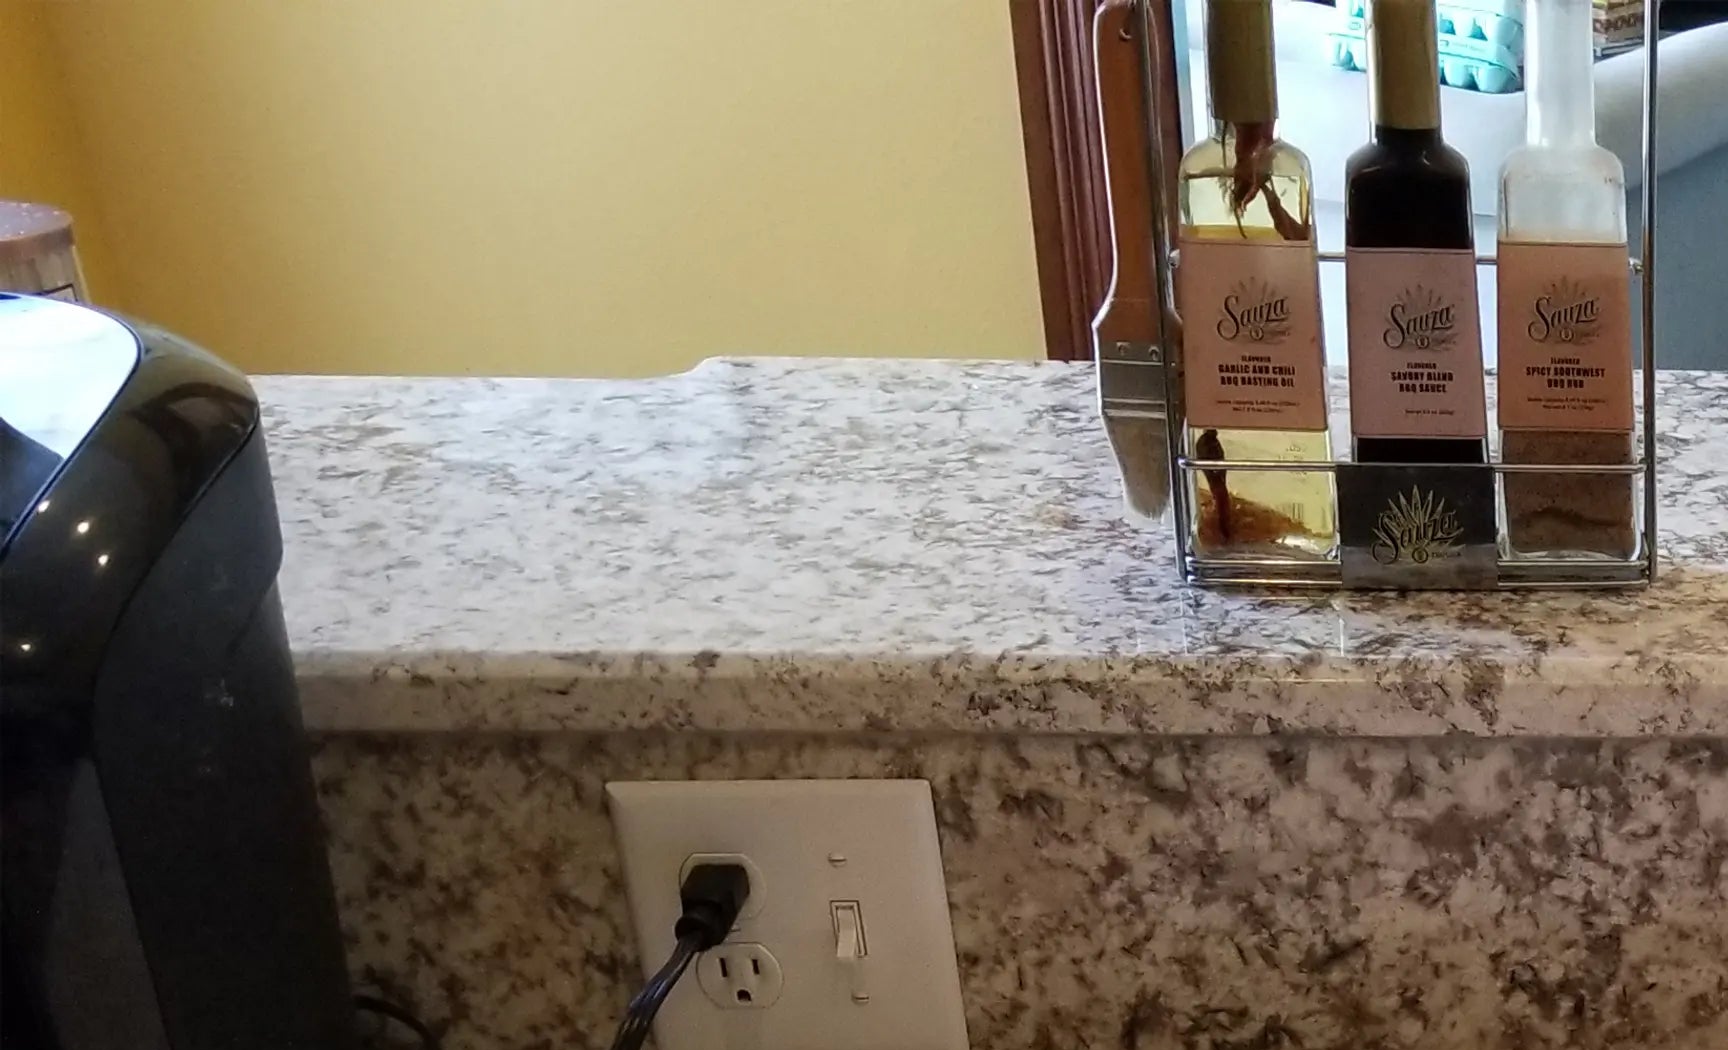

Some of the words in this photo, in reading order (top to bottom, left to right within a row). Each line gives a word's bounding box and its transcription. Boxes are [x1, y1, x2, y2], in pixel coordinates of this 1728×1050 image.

[1217, 295, 1290, 340] Sauza
[1383, 304, 1455, 349] Sauza
[1528, 296, 1600, 342] Sauza
[1218, 364, 1250, 374] GARLIC
[1252, 365, 1270, 374] AND
[1281, 378, 1295, 387] OIL
[1526, 366, 1551, 377] SPICY
[1553, 367, 1606, 378] SOUTHWEST
[1419, 384, 1447, 393] SAUCE
[1371, 509, 1465, 565] Sauza
